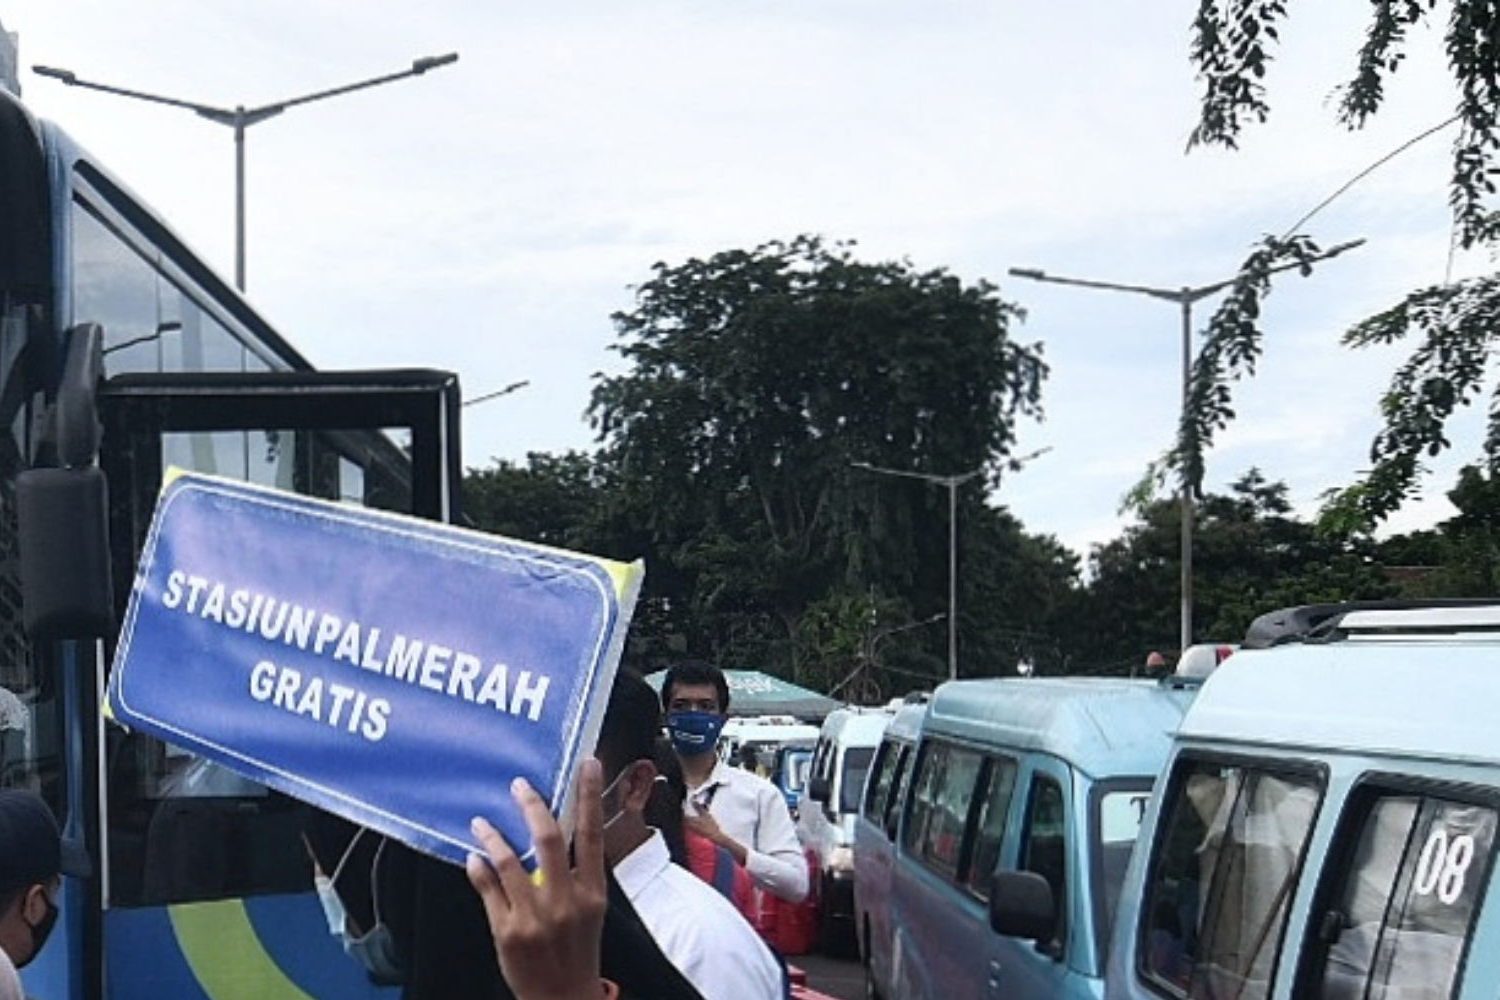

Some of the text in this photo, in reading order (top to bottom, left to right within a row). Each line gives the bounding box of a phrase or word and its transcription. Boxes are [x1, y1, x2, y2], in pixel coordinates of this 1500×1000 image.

[162, 569, 550, 722] STASIUN PALMERAH
[249, 660, 392, 741] GRATIS
[1414, 829, 1474, 904] 08
